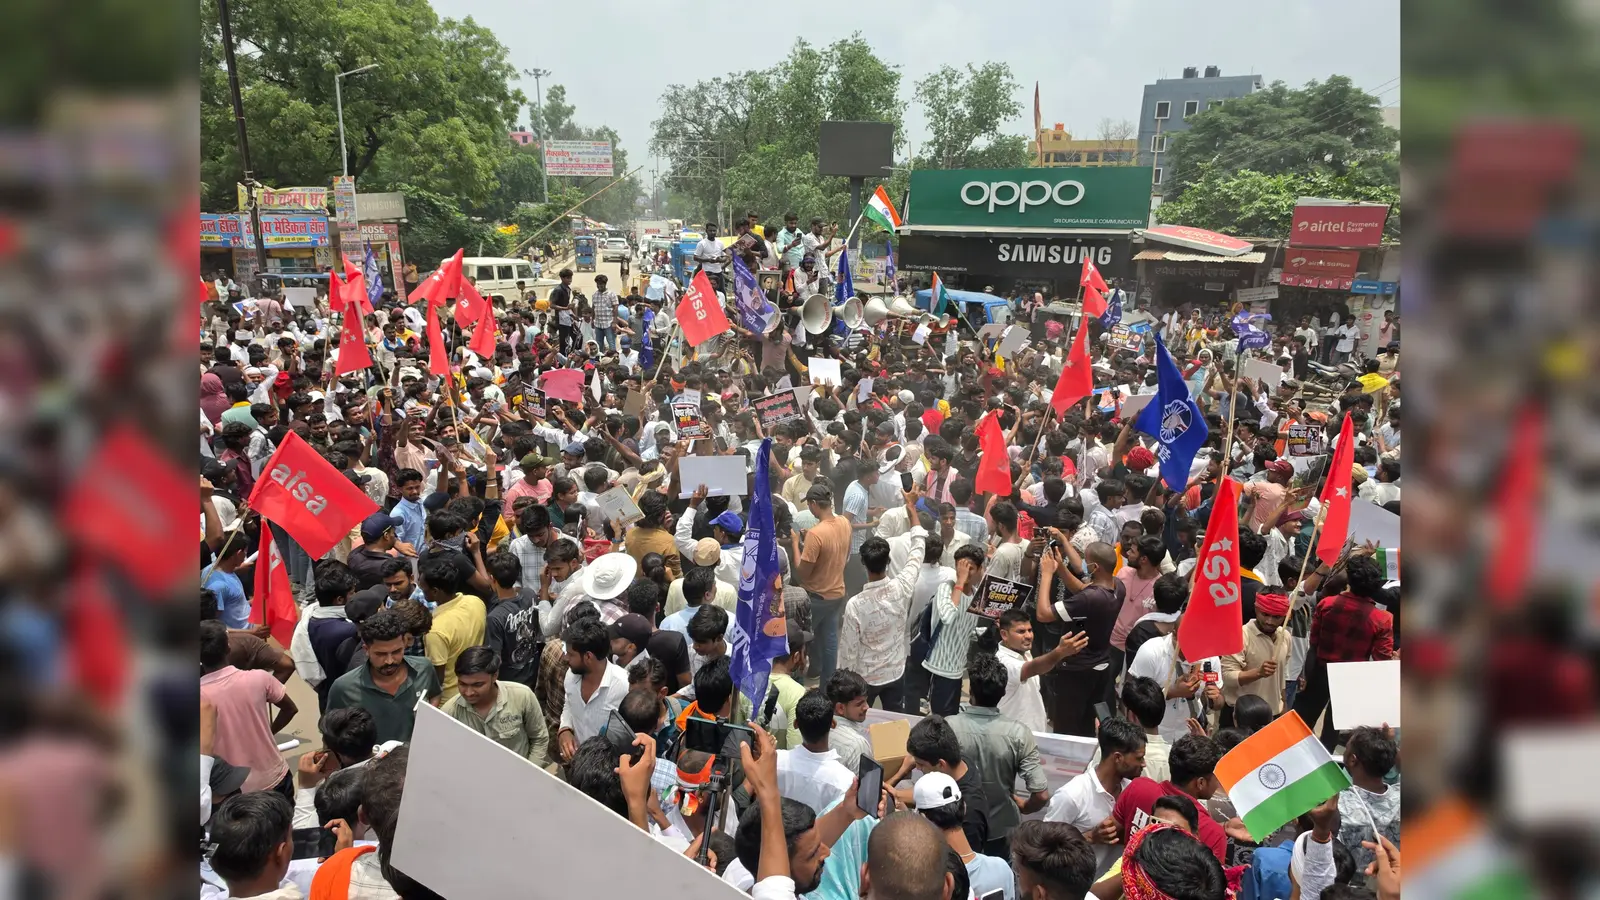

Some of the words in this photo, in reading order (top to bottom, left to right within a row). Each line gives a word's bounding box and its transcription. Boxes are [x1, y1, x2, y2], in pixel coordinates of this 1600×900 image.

[275, 217, 307, 234] मेडिकल
[310, 216, 326, 234] हॉल
[361, 226, 385, 234] ROSE
[1310, 220, 1345, 233] airtel
[1176, 228, 1234, 245] NEROLAC
[997, 243, 1112, 265] SAMSUNG
[686, 285, 708, 321] aisa
[270, 462, 329, 517] aisa
